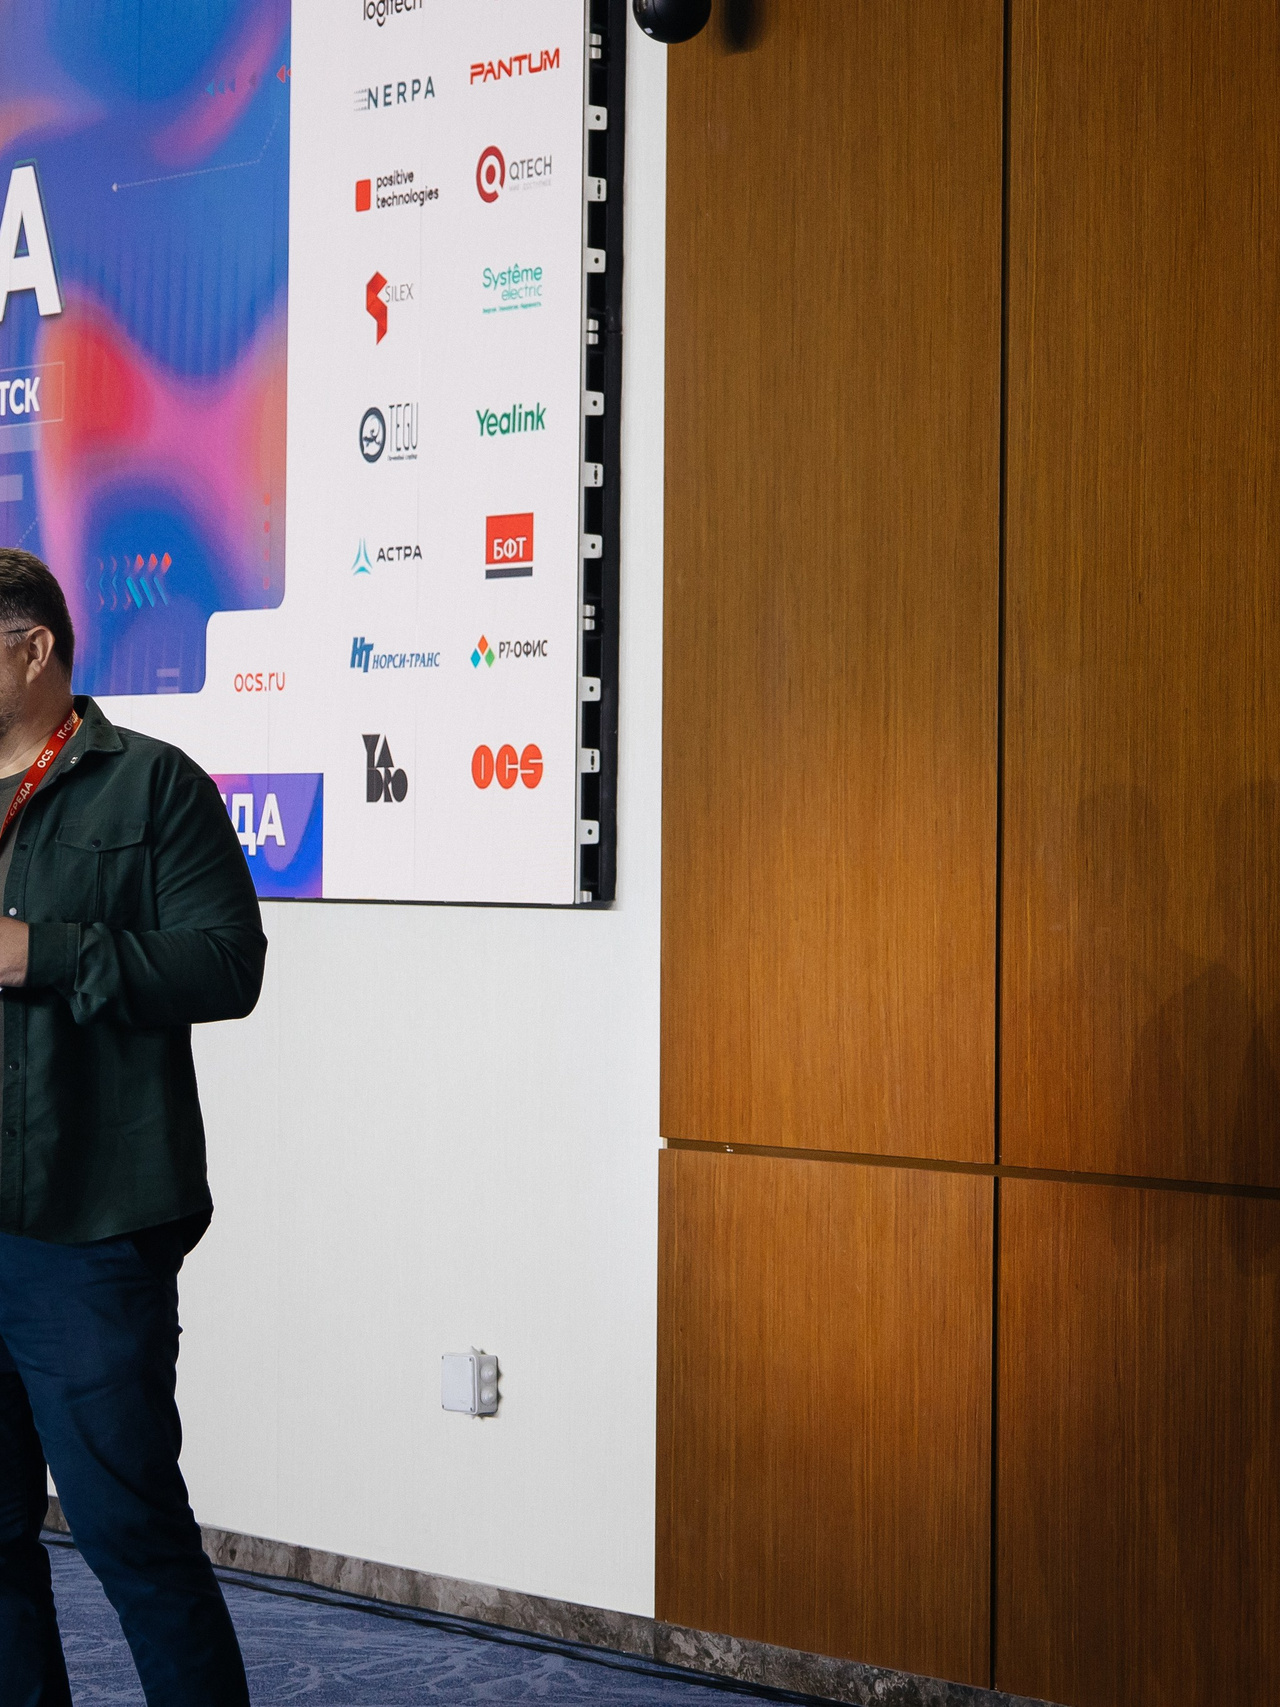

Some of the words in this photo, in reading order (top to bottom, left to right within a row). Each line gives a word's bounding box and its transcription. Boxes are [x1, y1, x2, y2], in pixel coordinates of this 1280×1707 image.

[470, 47, 560, 85] PANTUM
[368, 76, 435, 110] NERPA
[509, 155, 552, 181] QTECH
[376, 169, 414, 191] positive
[376, 187, 439, 209] technologies
[483, 263, 542, 291] Système
[385, 283, 414, 303] SILEX
[501, 284, 542, 301] electric
[389, 402, 418, 452] TEGU
[476, 402, 547, 437] Yealink
[377, 545, 423, 562] АСТРА
[493, 536, 527, 560] БФТ
[372, 652, 441, 669] НОРСИ-ТРАНС
[499, 640, 548, 659] Р7-ОФИС
[233, 672, 286, 693] ocs.ru
[37, 748, 54, 769] OCS
[471, 743, 543, 789] OCS
